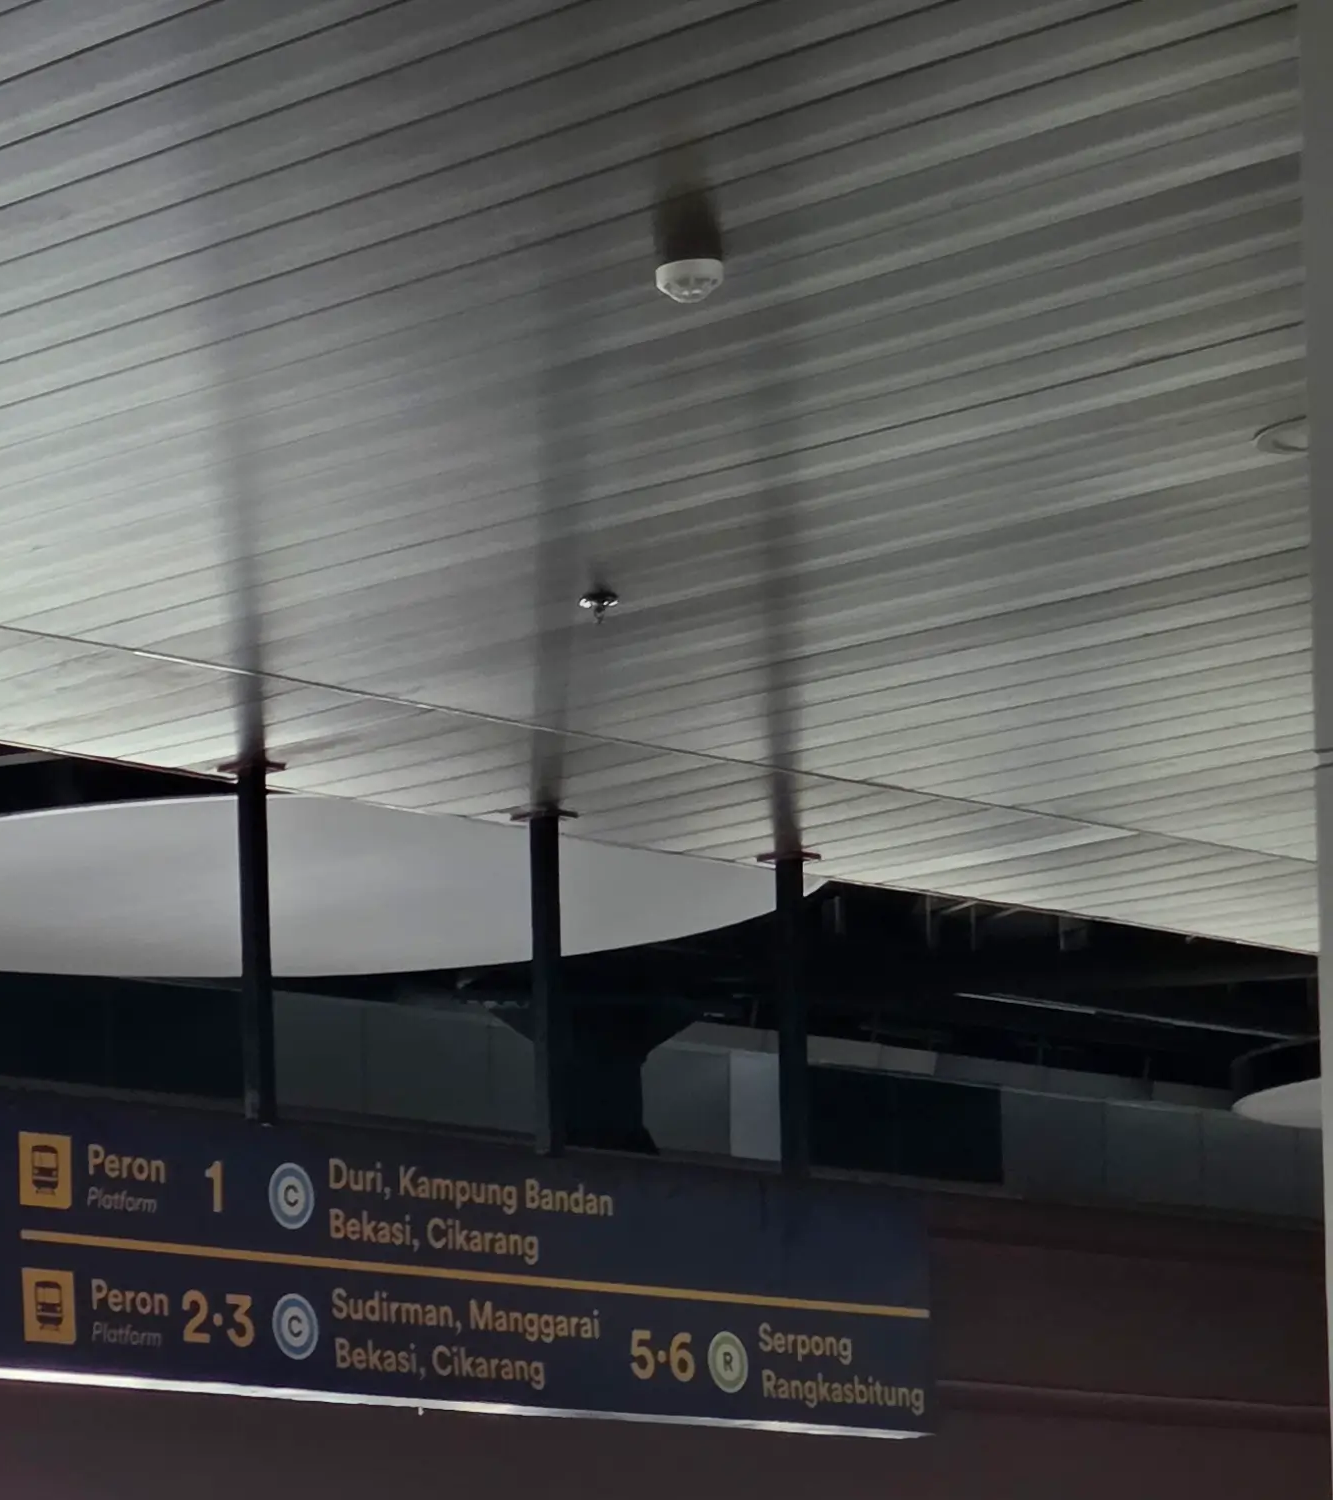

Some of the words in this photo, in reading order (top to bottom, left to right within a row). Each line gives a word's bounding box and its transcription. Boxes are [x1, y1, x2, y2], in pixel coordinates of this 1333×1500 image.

[86, 1186, 158, 1213] Platform
[87, 1143, 167, 1184] Peron
[204, 1160, 223, 1213] 1
[283, 1184, 300, 1207] C
[328, 1158, 391, 1200] Duri,
[398, 1165, 518, 1215] Kampung
[524, 1178, 614, 1216] Bandan
[328, 1208, 420, 1252] Bekasi,
[426, 1217, 540, 1265] Cikarang
[91, 1278, 170, 1317] Peron
[332, 1288, 463, 1335] Sudirman,
[469, 1298, 601, 1343] Manggarai
[91, 1321, 163, 1347] Platform
[287, 1315, 304, 1338] C
[758, 1322, 853, 1366] Serpong
[335, 1337, 427, 1381] Bekasi,
[432, 1345, 546, 1391] Cikarang
[761, 1369, 925, 1416] Rangkasbitung
